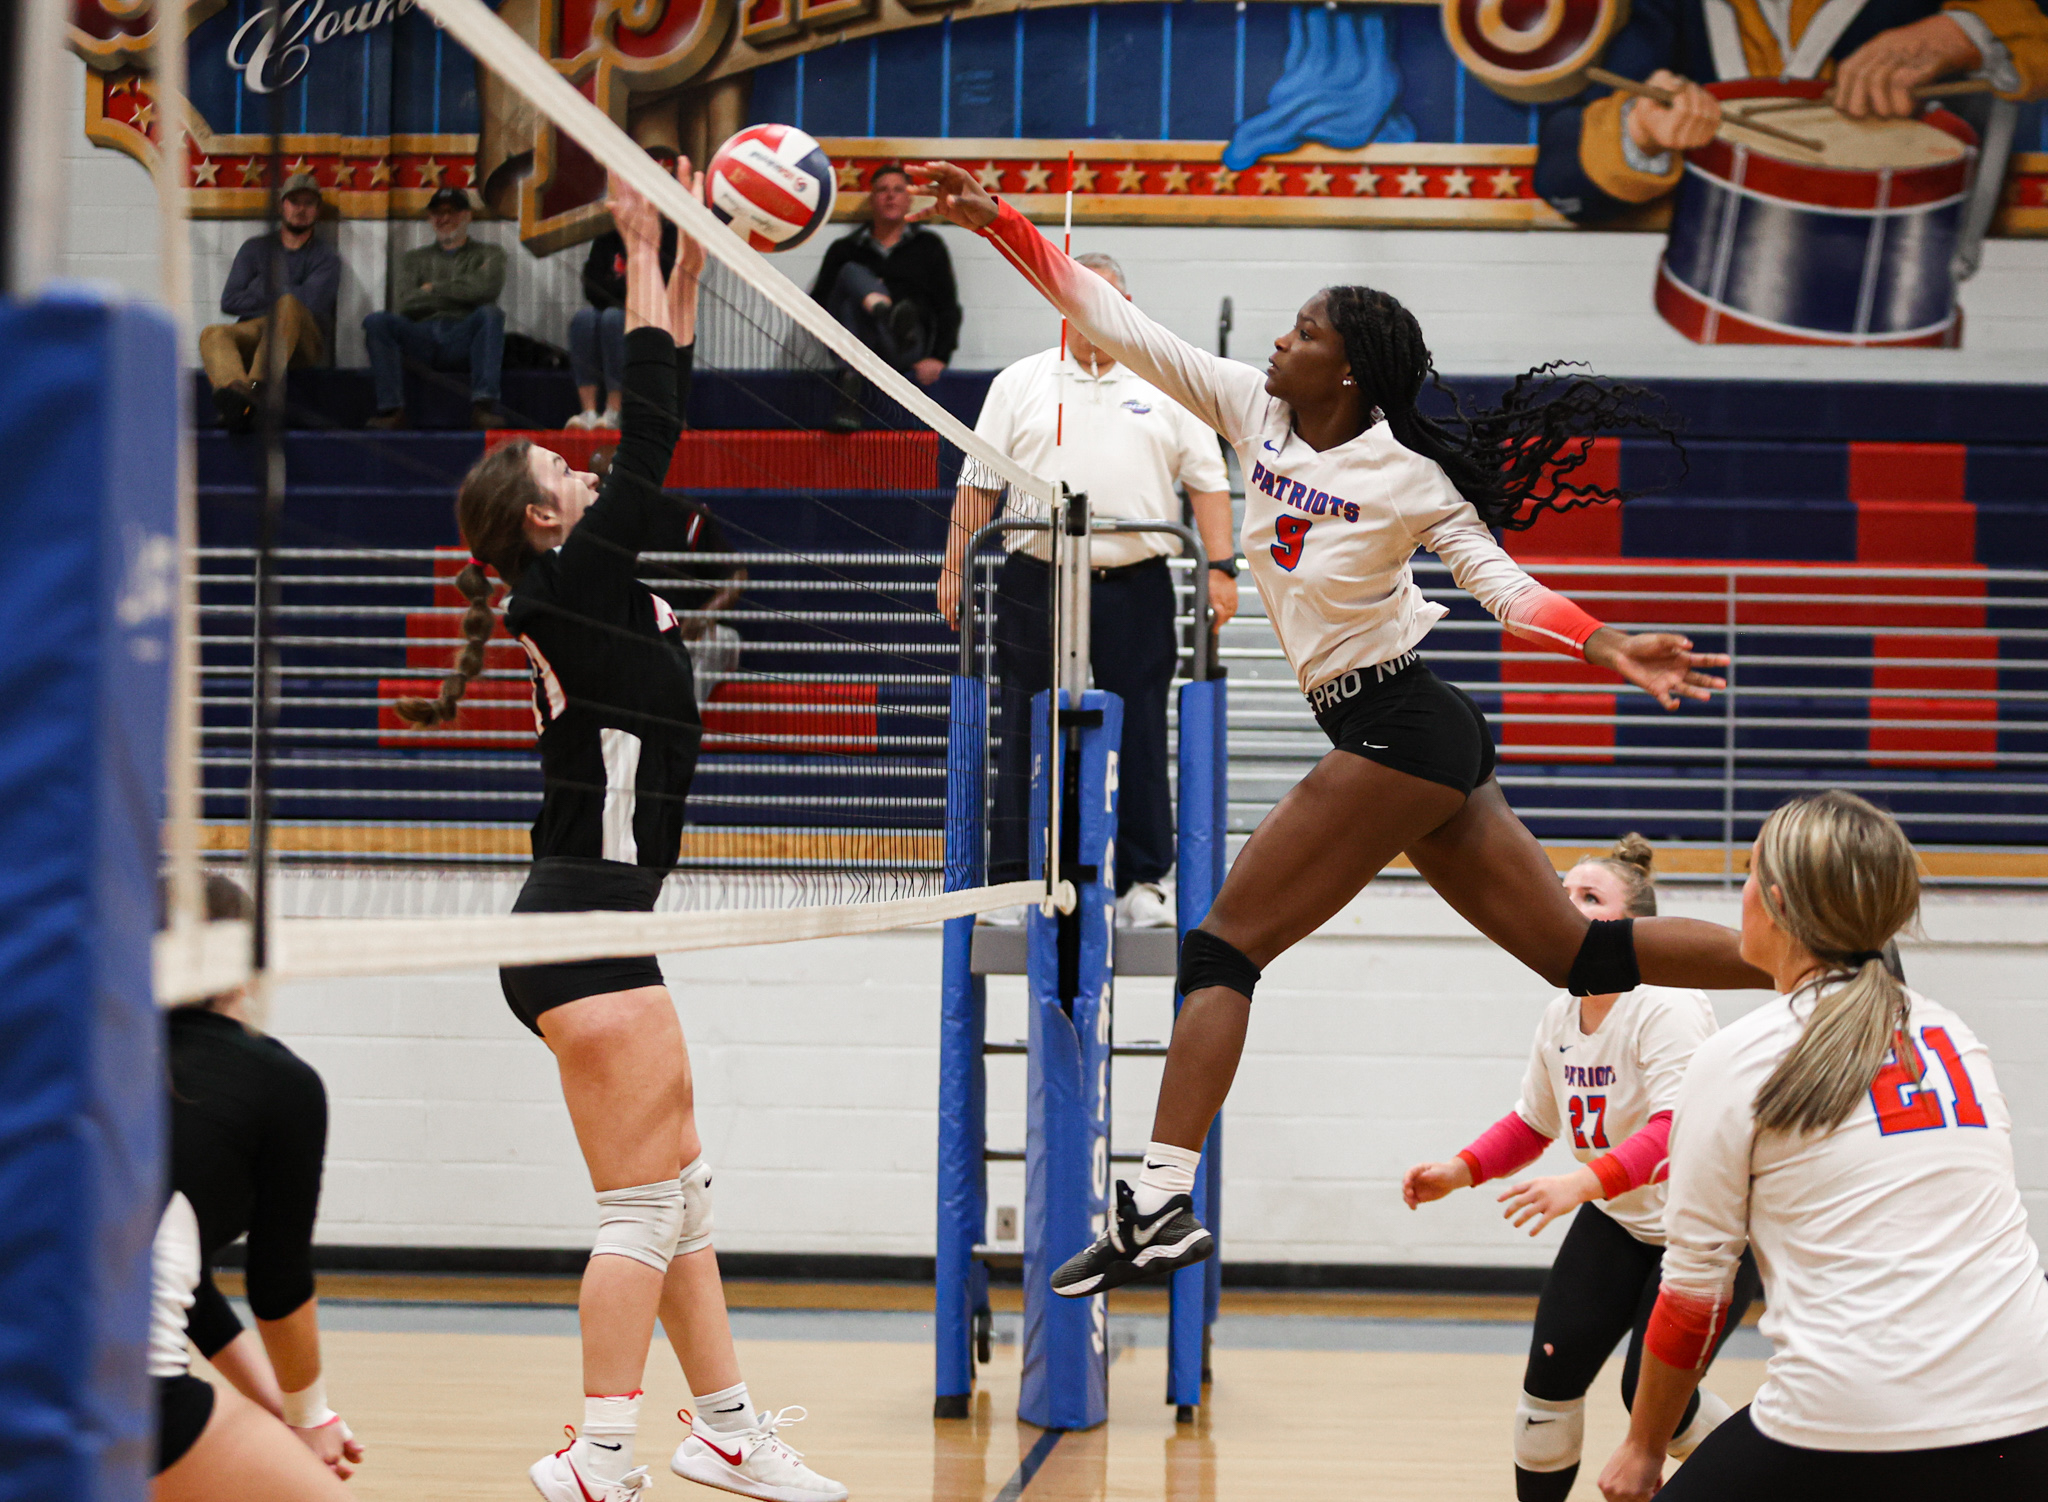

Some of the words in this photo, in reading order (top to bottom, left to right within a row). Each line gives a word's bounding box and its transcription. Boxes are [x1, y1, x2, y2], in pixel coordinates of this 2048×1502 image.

[1251, 459, 1361, 524] PATRIOTS
[1270, 513, 1313, 572] 9
[1312, 669, 1362, 713] PRO
[1868, 1025, 1989, 1136] 21
[1568, 1094, 1611, 1149] 27
